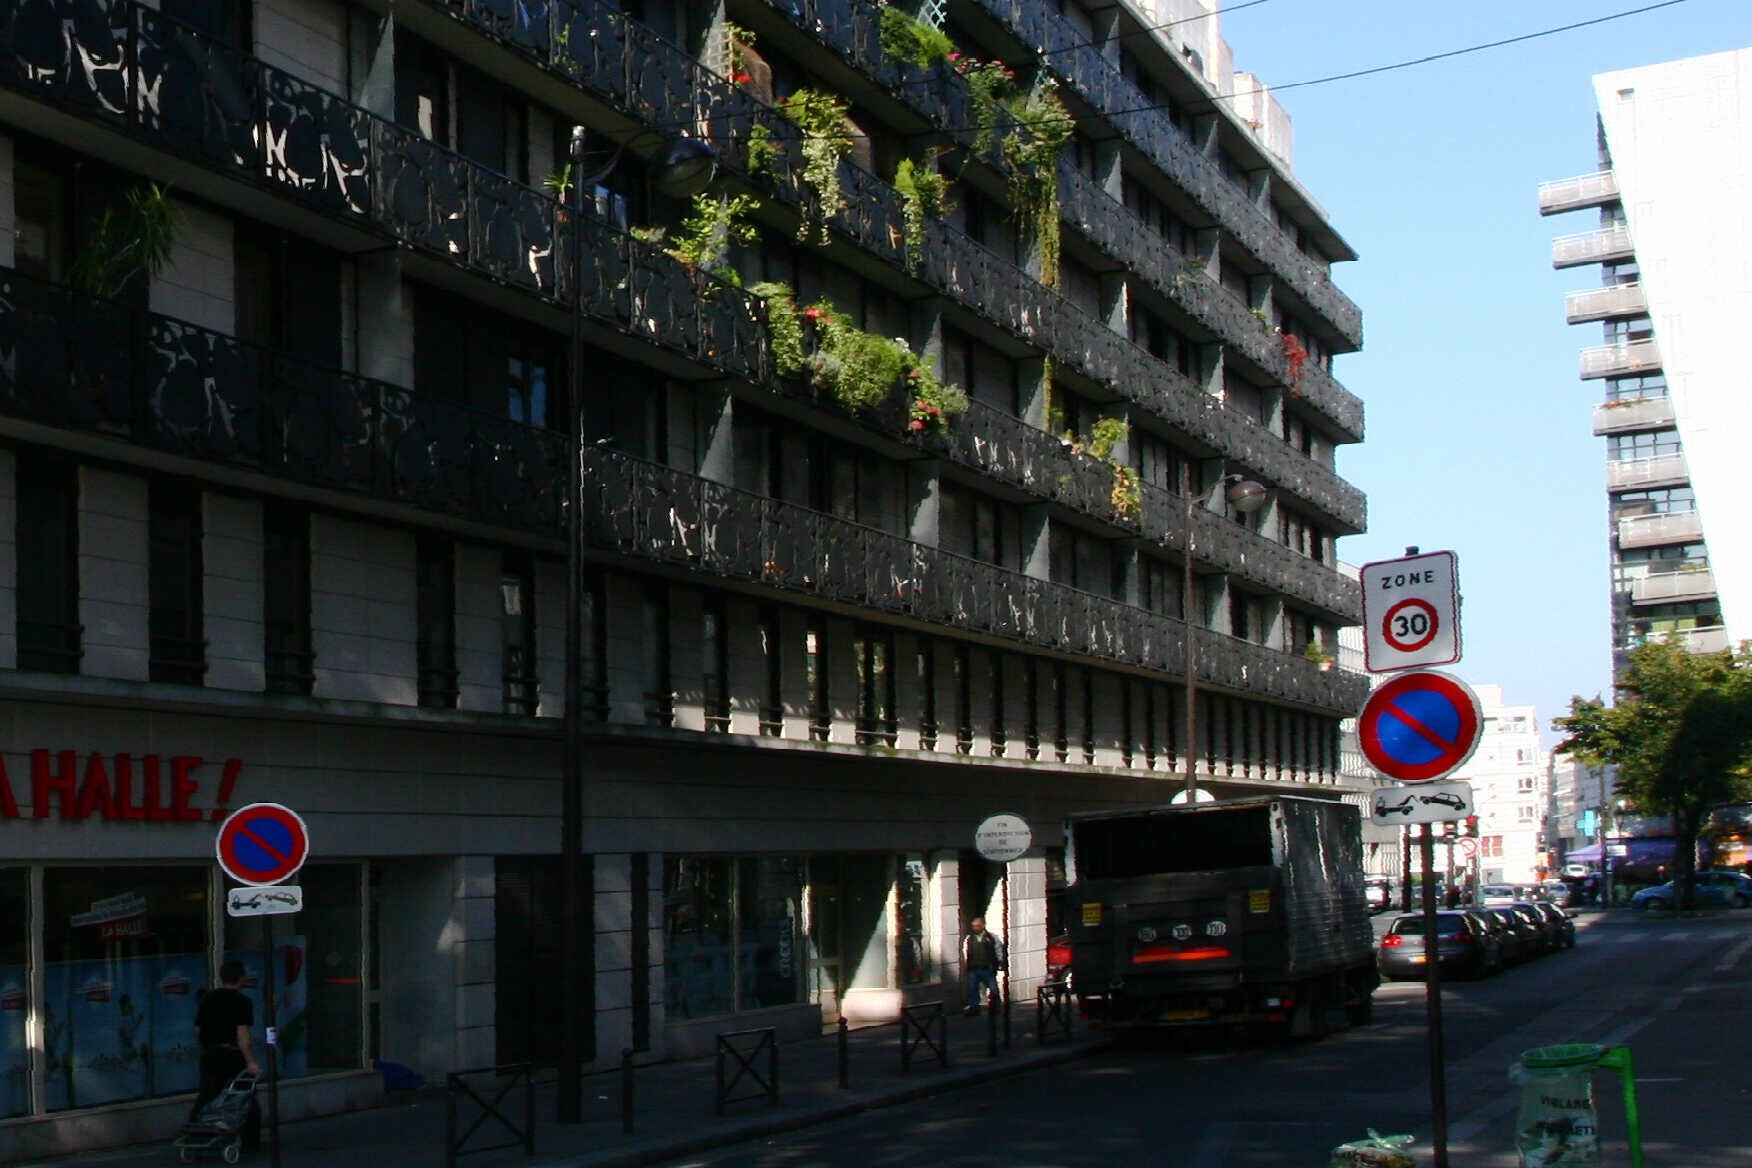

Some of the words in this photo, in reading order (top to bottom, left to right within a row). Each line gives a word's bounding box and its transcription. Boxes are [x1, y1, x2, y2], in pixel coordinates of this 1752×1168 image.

[1381, 571, 1434, 589] ZONE
[1394, 614, 1428, 637] 30
[31, 748, 203, 821] HALLE
